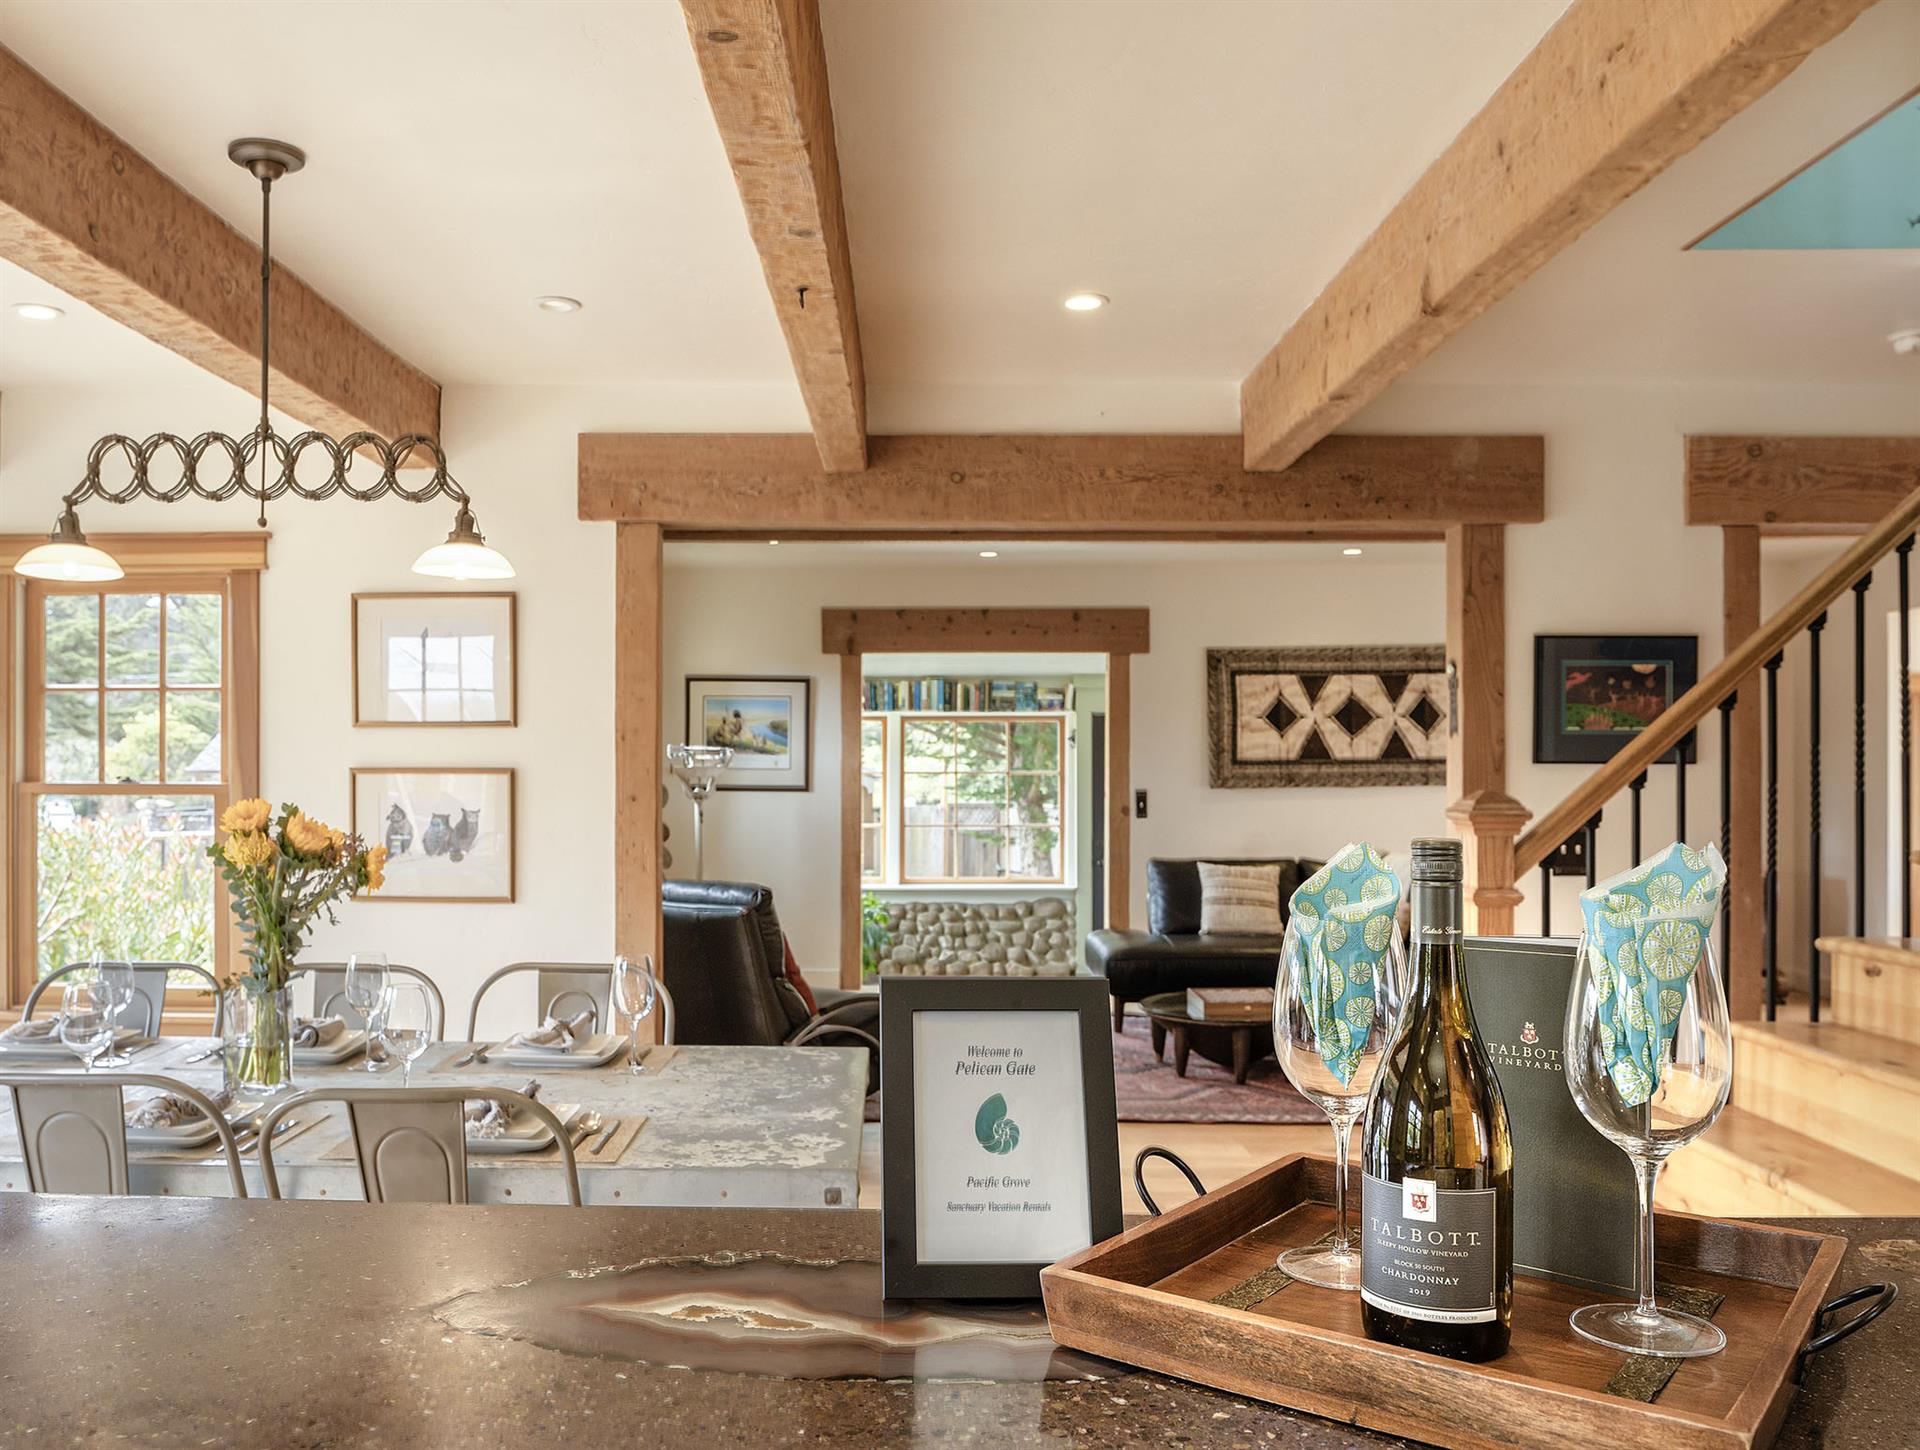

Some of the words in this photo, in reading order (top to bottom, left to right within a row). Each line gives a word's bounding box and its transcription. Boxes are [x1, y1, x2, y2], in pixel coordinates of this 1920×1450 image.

[967, 1045, 1011, 1058] Welcome
[1013, 1047, 1023, 1058] to
[955, 1061, 1002, 1075] Pelican
[1006, 1061, 1036, 1076] Gate
[966, 1176, 1000, 1190] Pacific
[1002, 1176, 1031, 1188] Grove
[946, 1201, 986, 1214] Sanctuary
[988, 1201, 1021, 1212] Vacation
[1022, 1201, 1052, 1212] Rentals
[1398, 1244, 1430, 1256] HOLLOW
[1431, 1249, 1469, 1258] VINEYARD
[1394, 1259, 1414, 1268] BLOCK
[1422, 1264, 1446, 1273] SOUTH
[1381, 1265, 1460, 1286] CHARDONNAY
[1408, 1287, 1431, 1297] 2019
